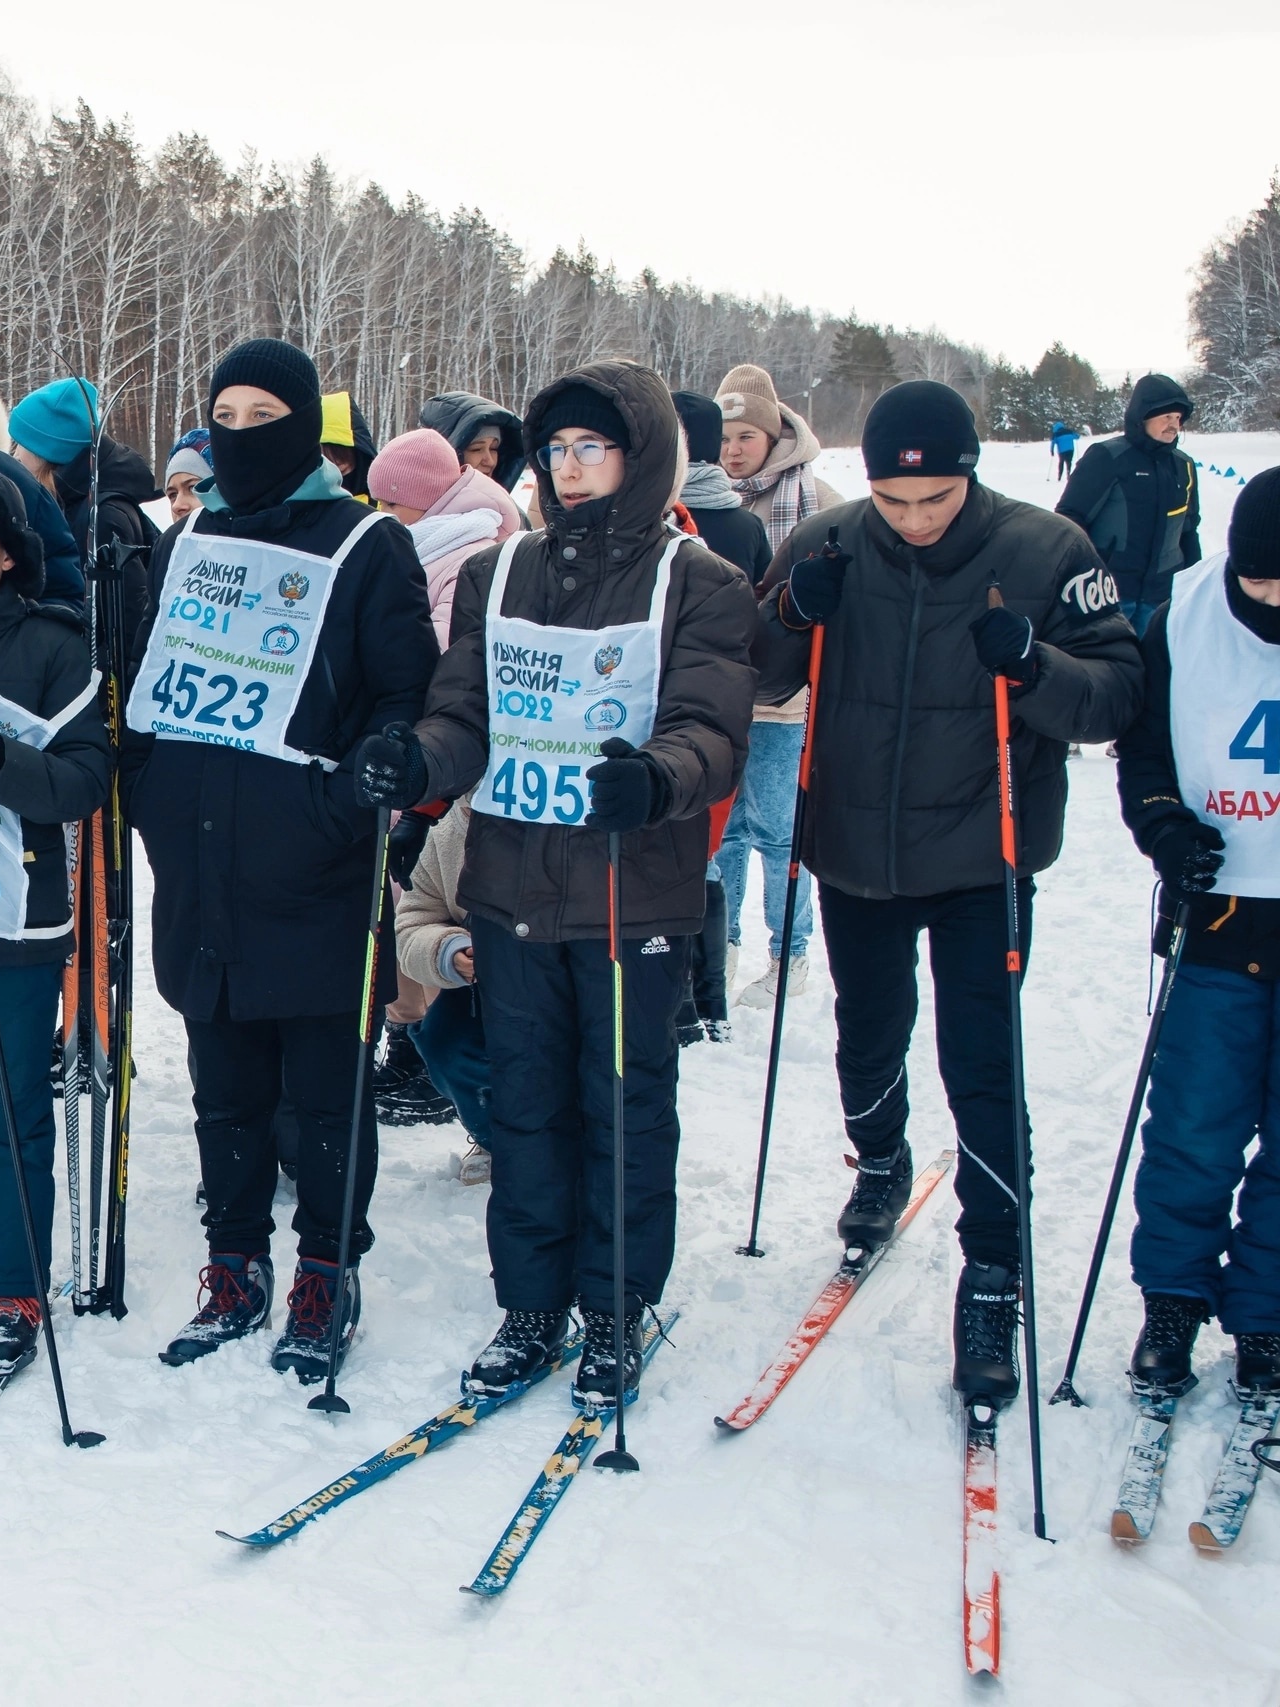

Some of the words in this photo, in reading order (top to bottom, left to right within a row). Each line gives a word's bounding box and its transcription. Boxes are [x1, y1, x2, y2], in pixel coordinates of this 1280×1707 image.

[181, 577, 243, 609] РОССИИ
[1061, 567, 1119, 614] Tele
[168, 596, 231, 634] 2021
[194, 643, 247, 667] НОРМА
[246, 658, 295, 676] ЖИЗНИ
[152, 658, 270, 731] 4523
[496, 665, 560, 693] ОССИИ
[495, 689, 553, 722] 2022
[527, 738, 577, 755] НОРМА
[492, 757, 596, 824] 495
[641, 944, 671, 955] adidas
[269, 1476, 359, 1536] NORDWAY
